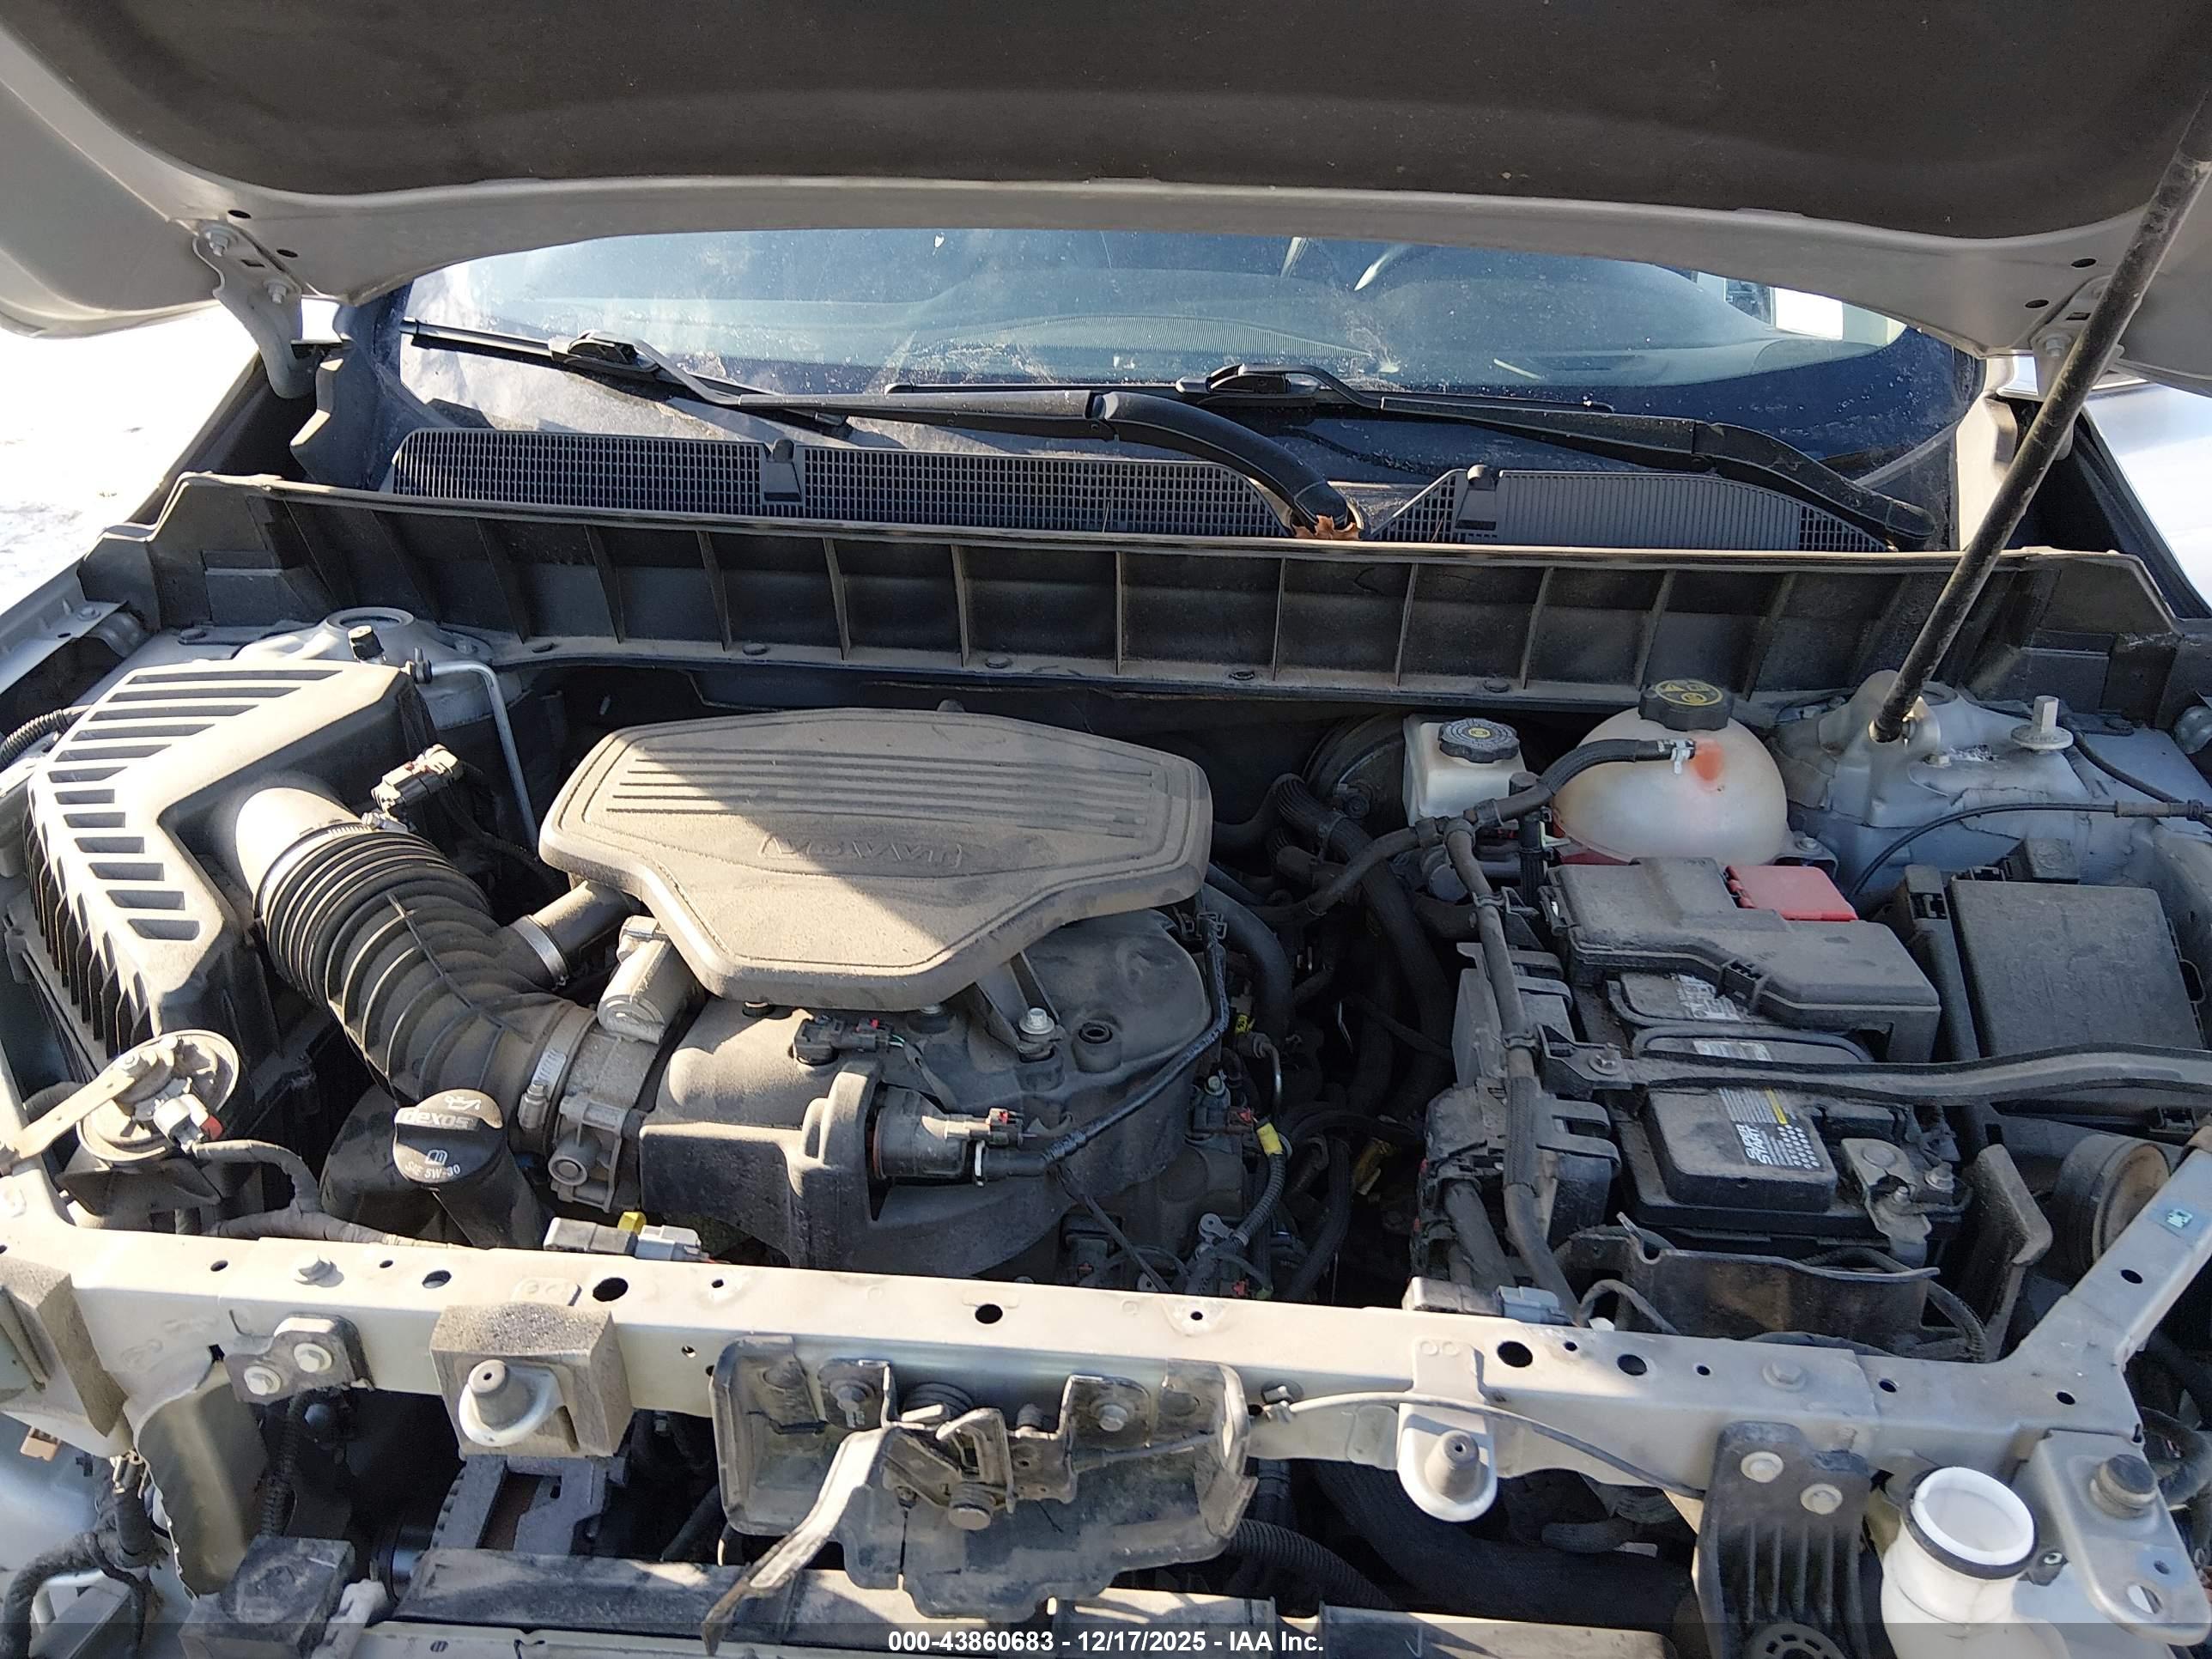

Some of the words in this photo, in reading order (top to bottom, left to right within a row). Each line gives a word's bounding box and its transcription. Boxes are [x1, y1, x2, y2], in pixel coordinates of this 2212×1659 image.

[404, 1107, 469, 1129] dexos
[1735, 1124, 1756, 1159] SUPER
[1744, 1124, 1773, 1165] START
[424, 1164, 461, 1180] 5W-30
